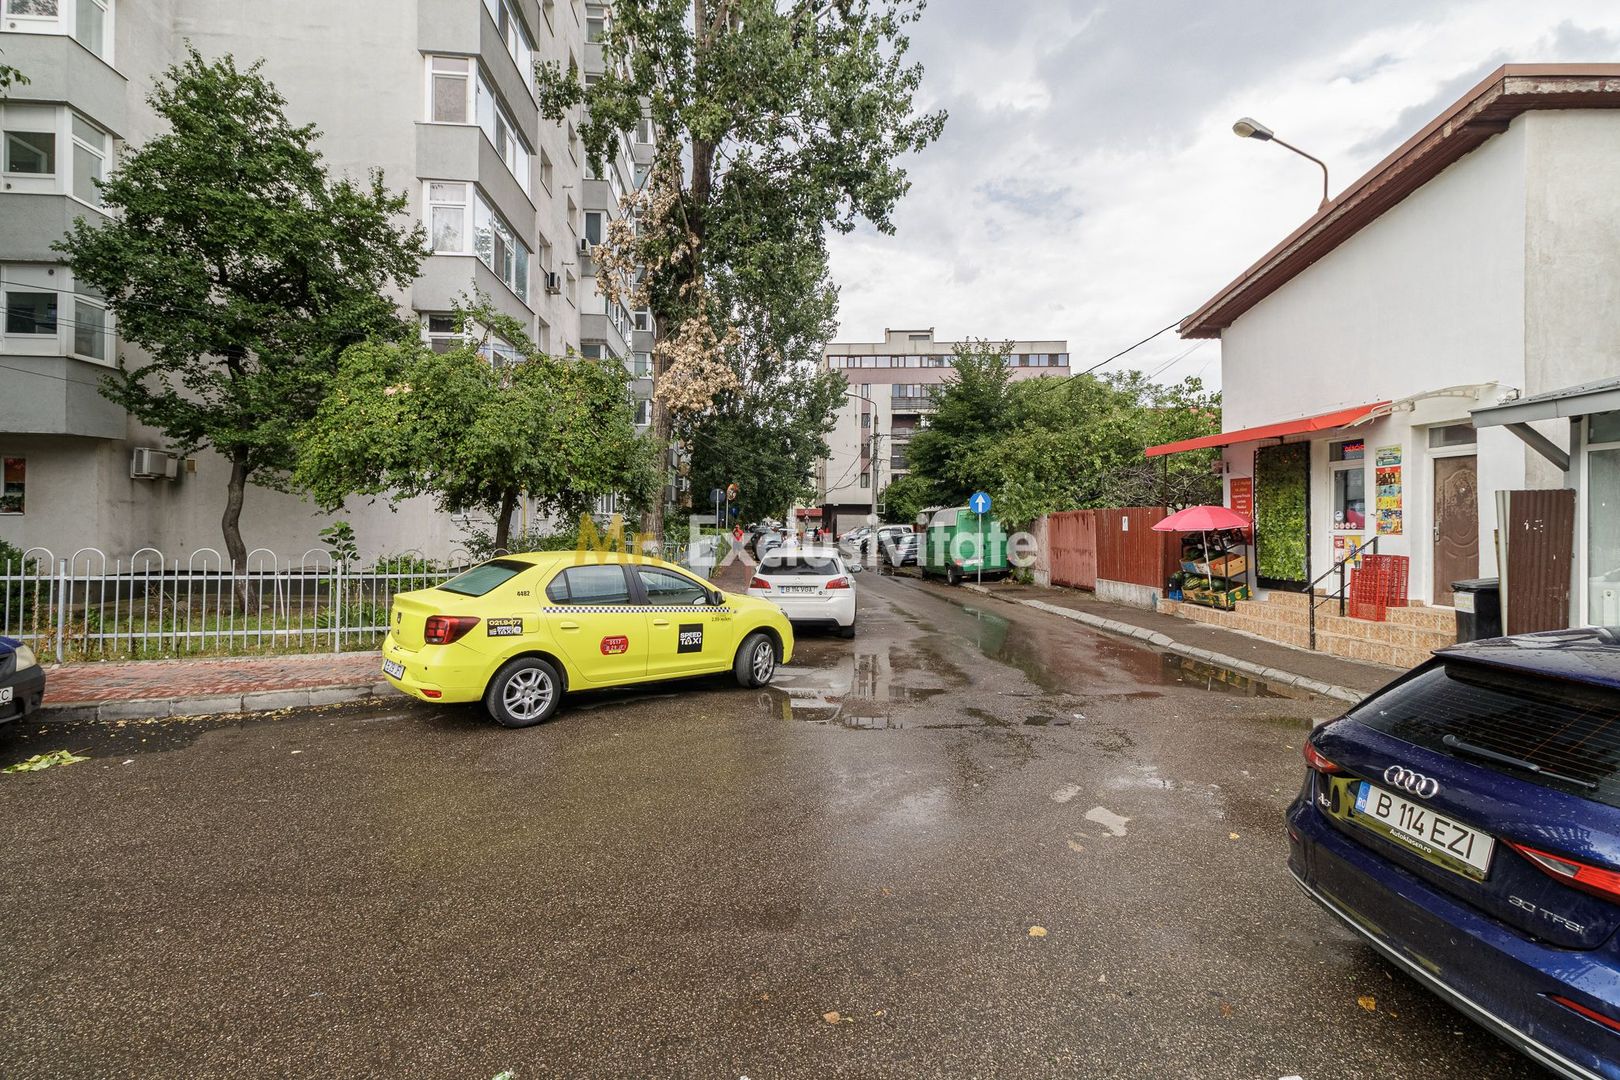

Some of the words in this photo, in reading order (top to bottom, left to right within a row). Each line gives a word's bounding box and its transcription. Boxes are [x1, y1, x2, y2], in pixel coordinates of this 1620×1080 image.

[679, 631, 702, 639] SPEED
[679, 636, 702, 646] TAXI
[1375, 792, 1393, 819] B
[1398, 803, 1426, 837] 114
[1429, 817, 1476, 860] EZI
[1389, 828, 1432, 854] Autoklasen.ro
[1508, 895, 1536, 913] 30
[1540, 908, 1585, 935] TFSI
